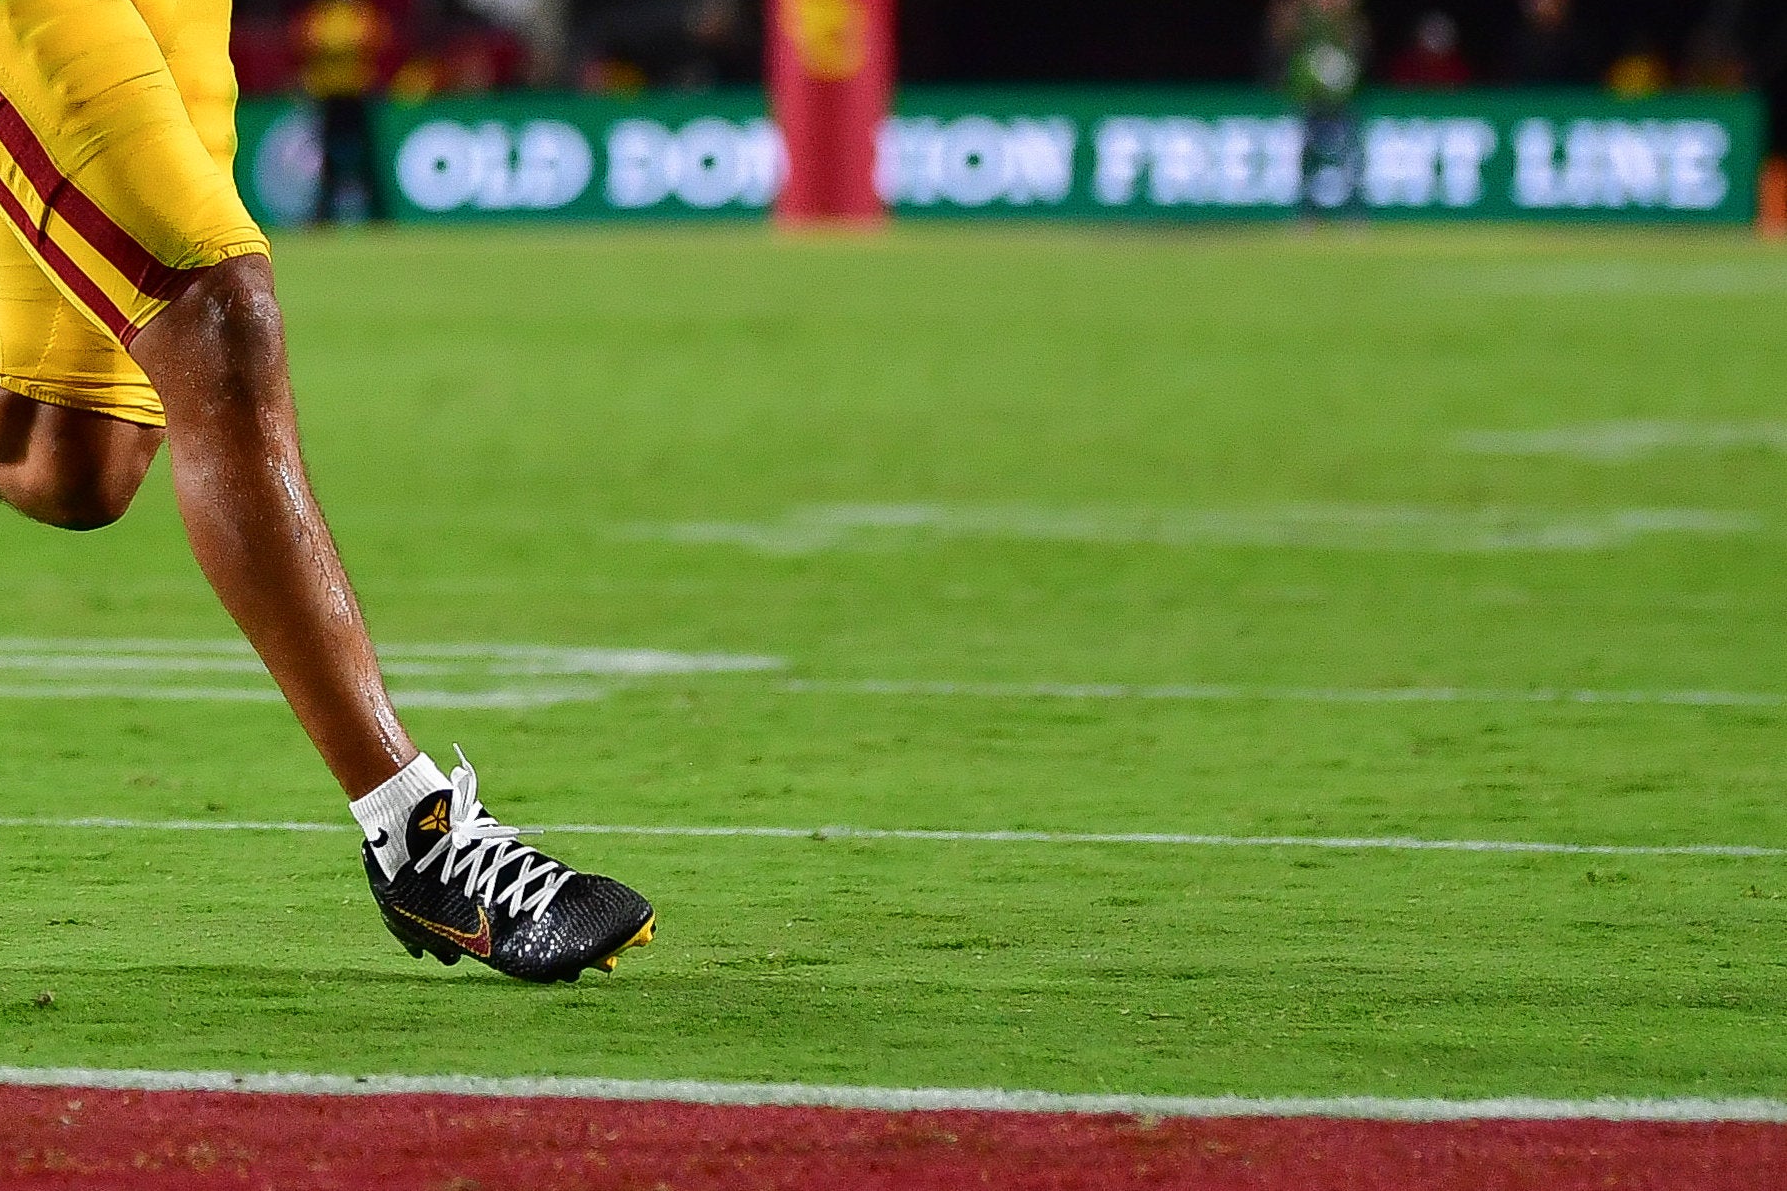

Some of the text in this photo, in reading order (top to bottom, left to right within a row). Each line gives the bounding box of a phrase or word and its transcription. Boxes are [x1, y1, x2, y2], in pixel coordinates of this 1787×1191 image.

[398, 120, 593, 210] OLD
[1095, 117, 1495, 207] FREIHT
[1512, 118, 1727, 208] LINE
